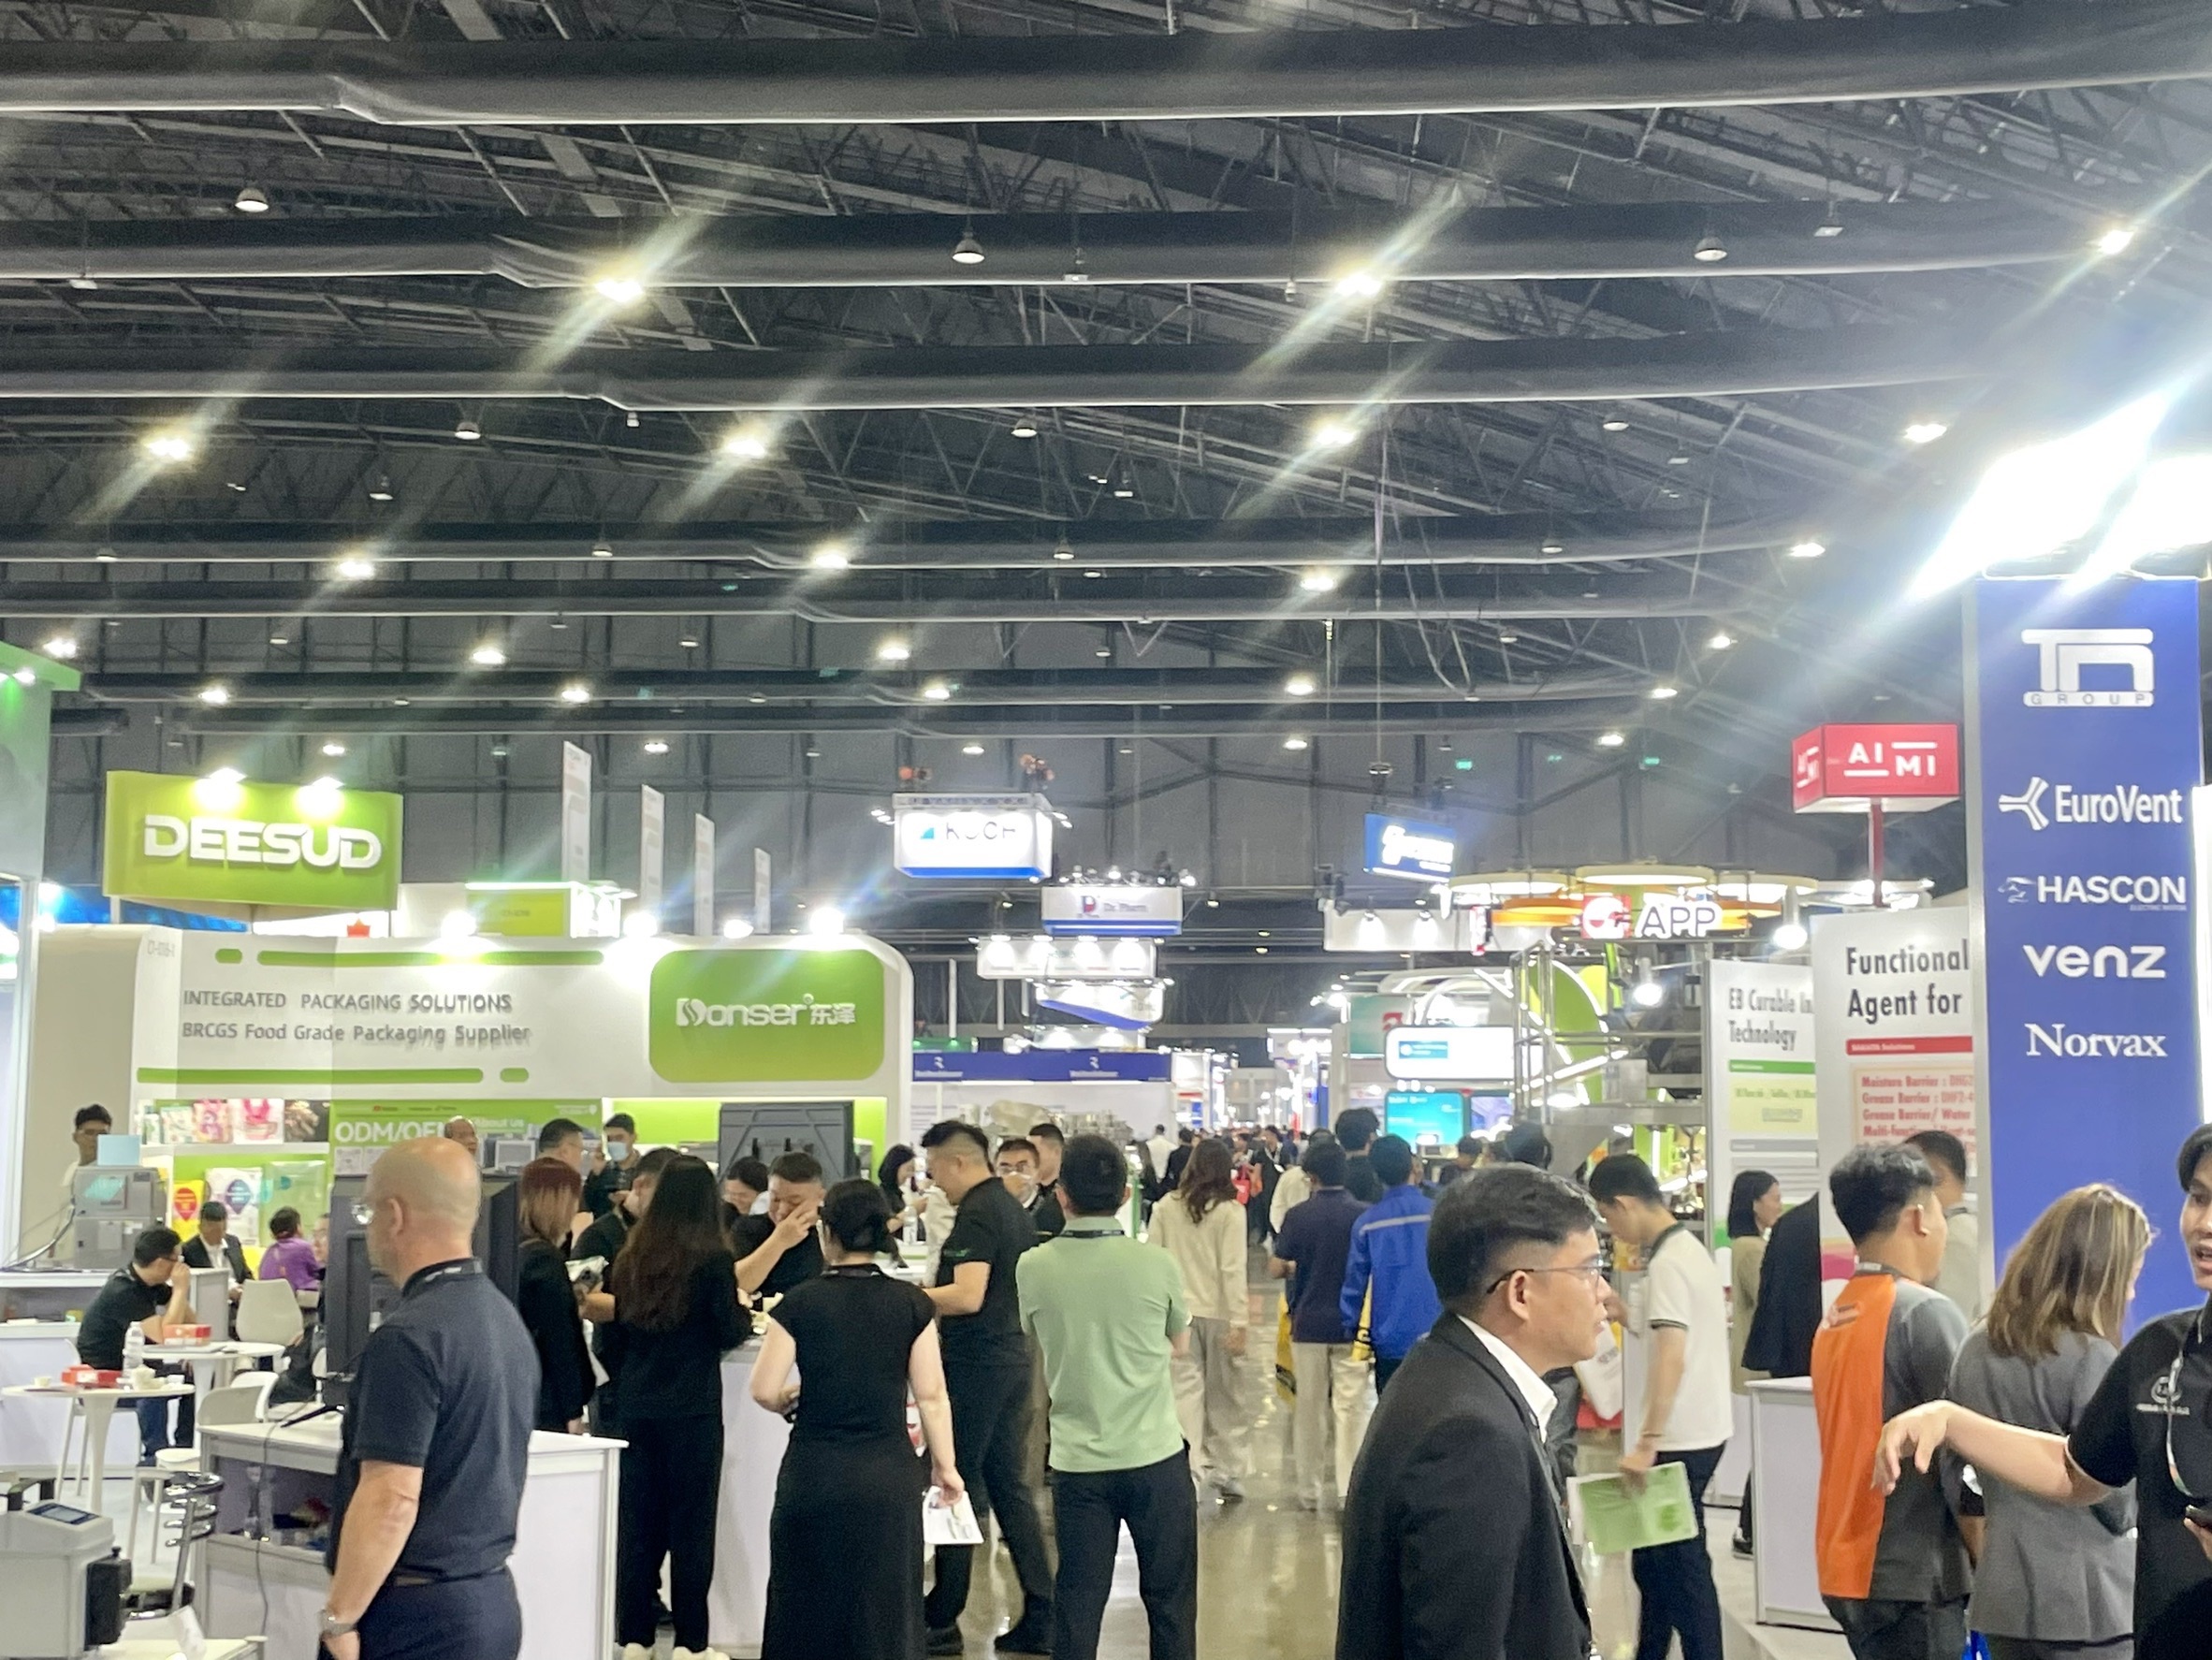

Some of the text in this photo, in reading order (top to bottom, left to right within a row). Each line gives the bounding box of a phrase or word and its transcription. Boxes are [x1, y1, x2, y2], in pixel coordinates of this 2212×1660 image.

[2030, 692, 2146, 706] GROUP
[2056, 784, 2184, 823] EuroVent
[144, 814, 383, 868] DEESUD
[2037, 876, 2187, 903] HASCON
[1641, 906, 1716, 937] APP
[1846, 939, 1970, 975] Functional
[2022, 945, 2166, 978] venz
[183, 990, 513, 1013] INTEGRATED PACKAGING SOLUTIONS
[676, 997, 808, 1027] Donser
[1847, 983, 1962, 1025] Agent for
[182, 1023, 531, 1045] BRCGS Food Grade Packaging Supplier
[1729, 1019, 1797, 1052] Technology
[2024, 1023, 2168, 1057] Norvax
[335, 1121, 444, 1143] ODM/OE
